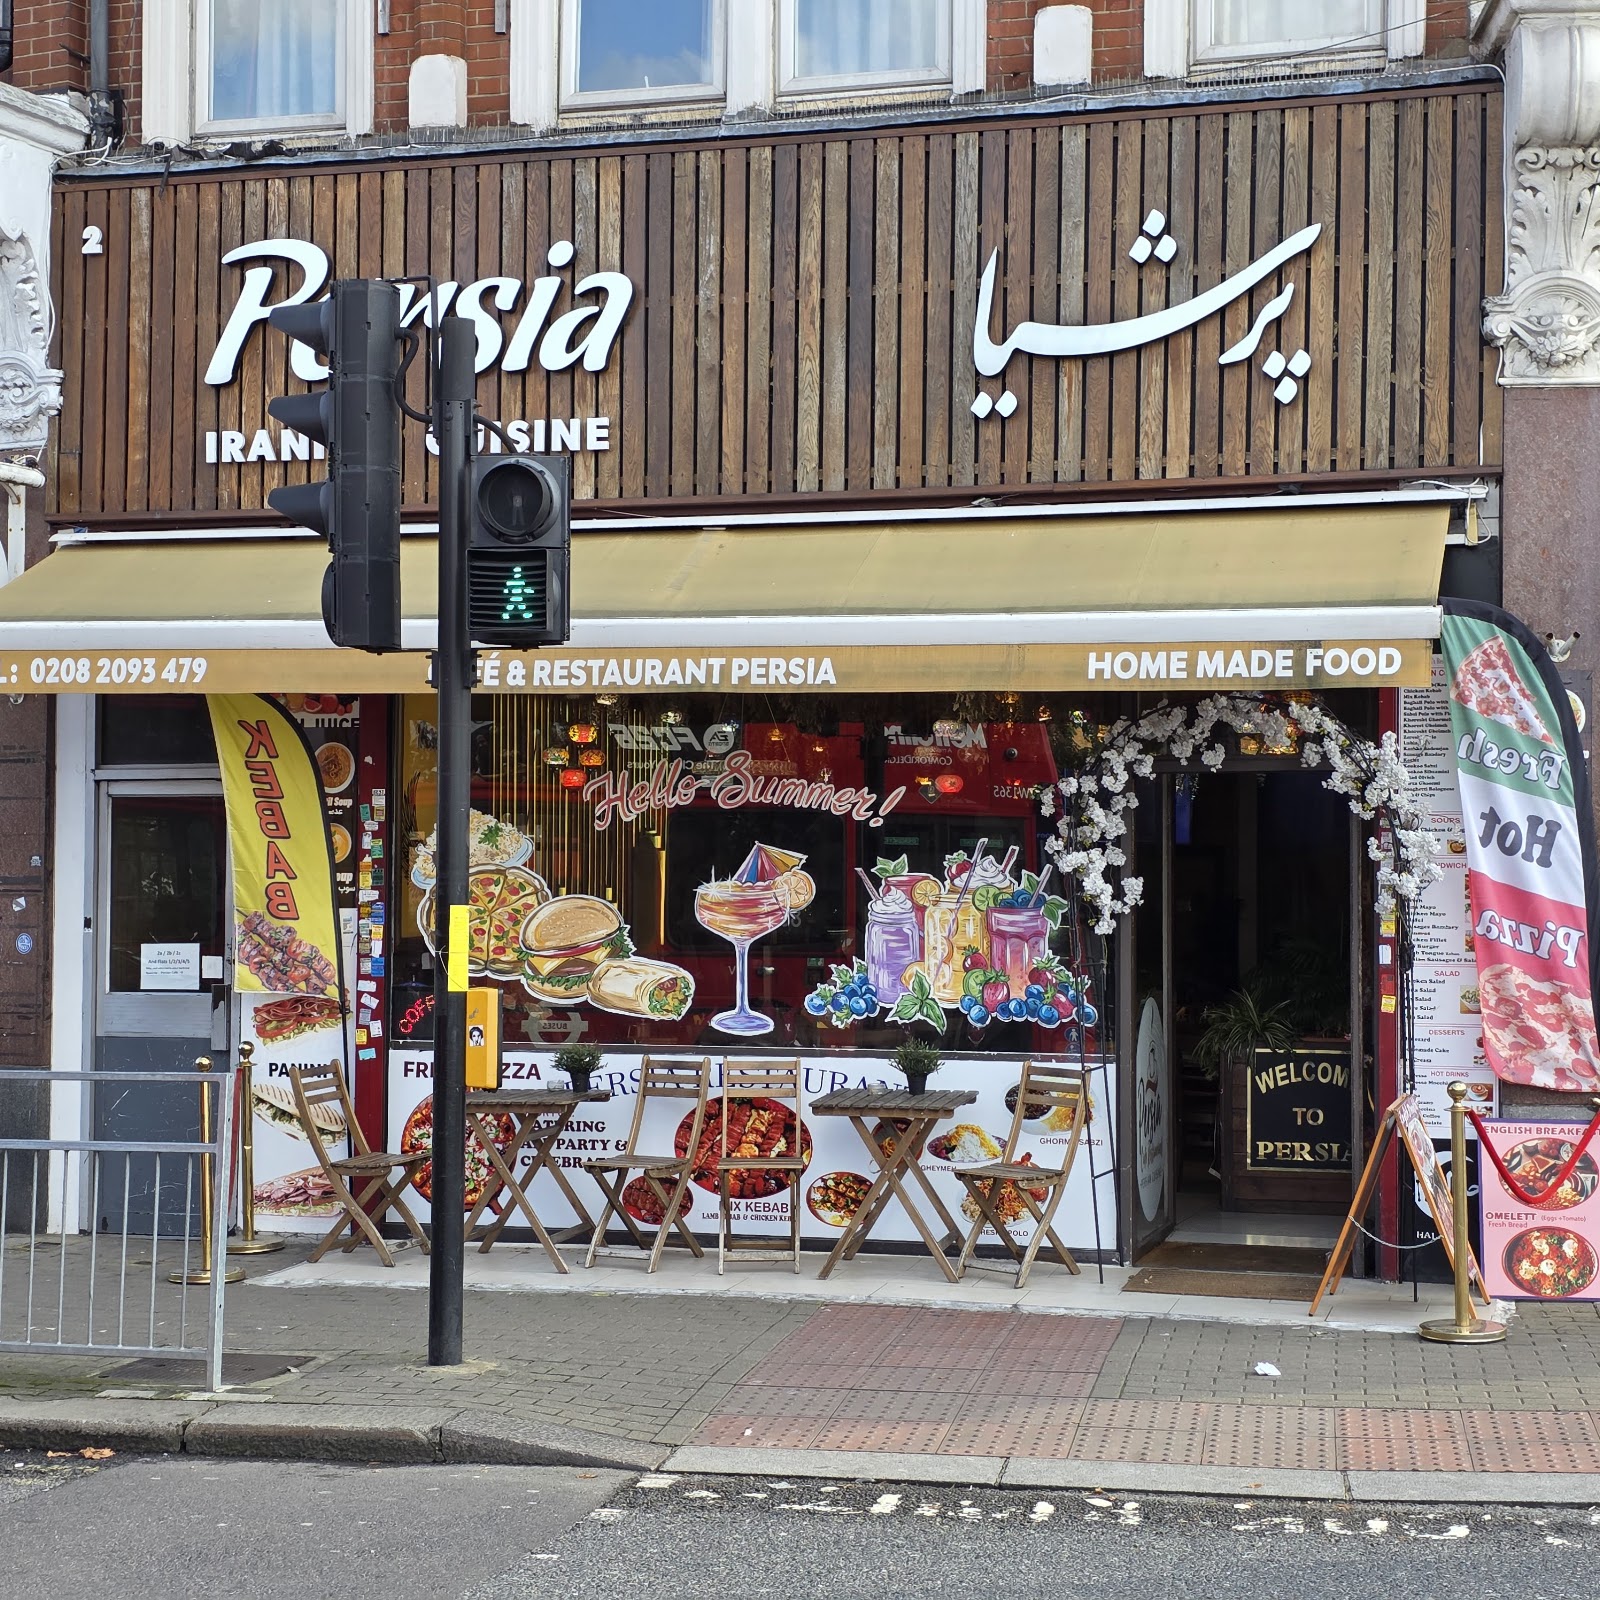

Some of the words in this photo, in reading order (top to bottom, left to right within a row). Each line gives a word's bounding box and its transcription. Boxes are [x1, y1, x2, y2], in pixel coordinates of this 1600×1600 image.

[81, 225, 103, 254] 2
[970, 208, 1322, 419] پرشیا
[30, 657, 91, 684] 0208
[96, 657, 156, 684] 2093
[161, 657, 207, 683] 479
[506, 658, 526, 687] &
[533, 656, 726, 687] RESTAURANT
[731, 656, 837, 685] PERSIA
[1087, 651, 1188, 680] HOME
[1196, 649, 1294, 679] MADE
[1305, 647, 1402, 677] FOOD
[583, 756, 710, 831] Hello
[711, 750, 907, 828] Summer!
[1292, 1107, 1325, 1126] TO
[556, 1138, 611, 1151] PARTY
[615, 1140, 628, 1151] &
[702, 1212, 719, 1220] LAMB
[750, 1213, 779, 1222] CHICKEN
[730, 1201, 741, 1212] IX
[745, 1201, 789, 1213] KEBAB
[1485, 1212, 1537, 1221] OMELETT
[1558, 1215, 1587, 1223] +Tomato)
[1488, 1221, 1507, 1229] Fresh
[1508, 1221, 1528, 1229] Bread
